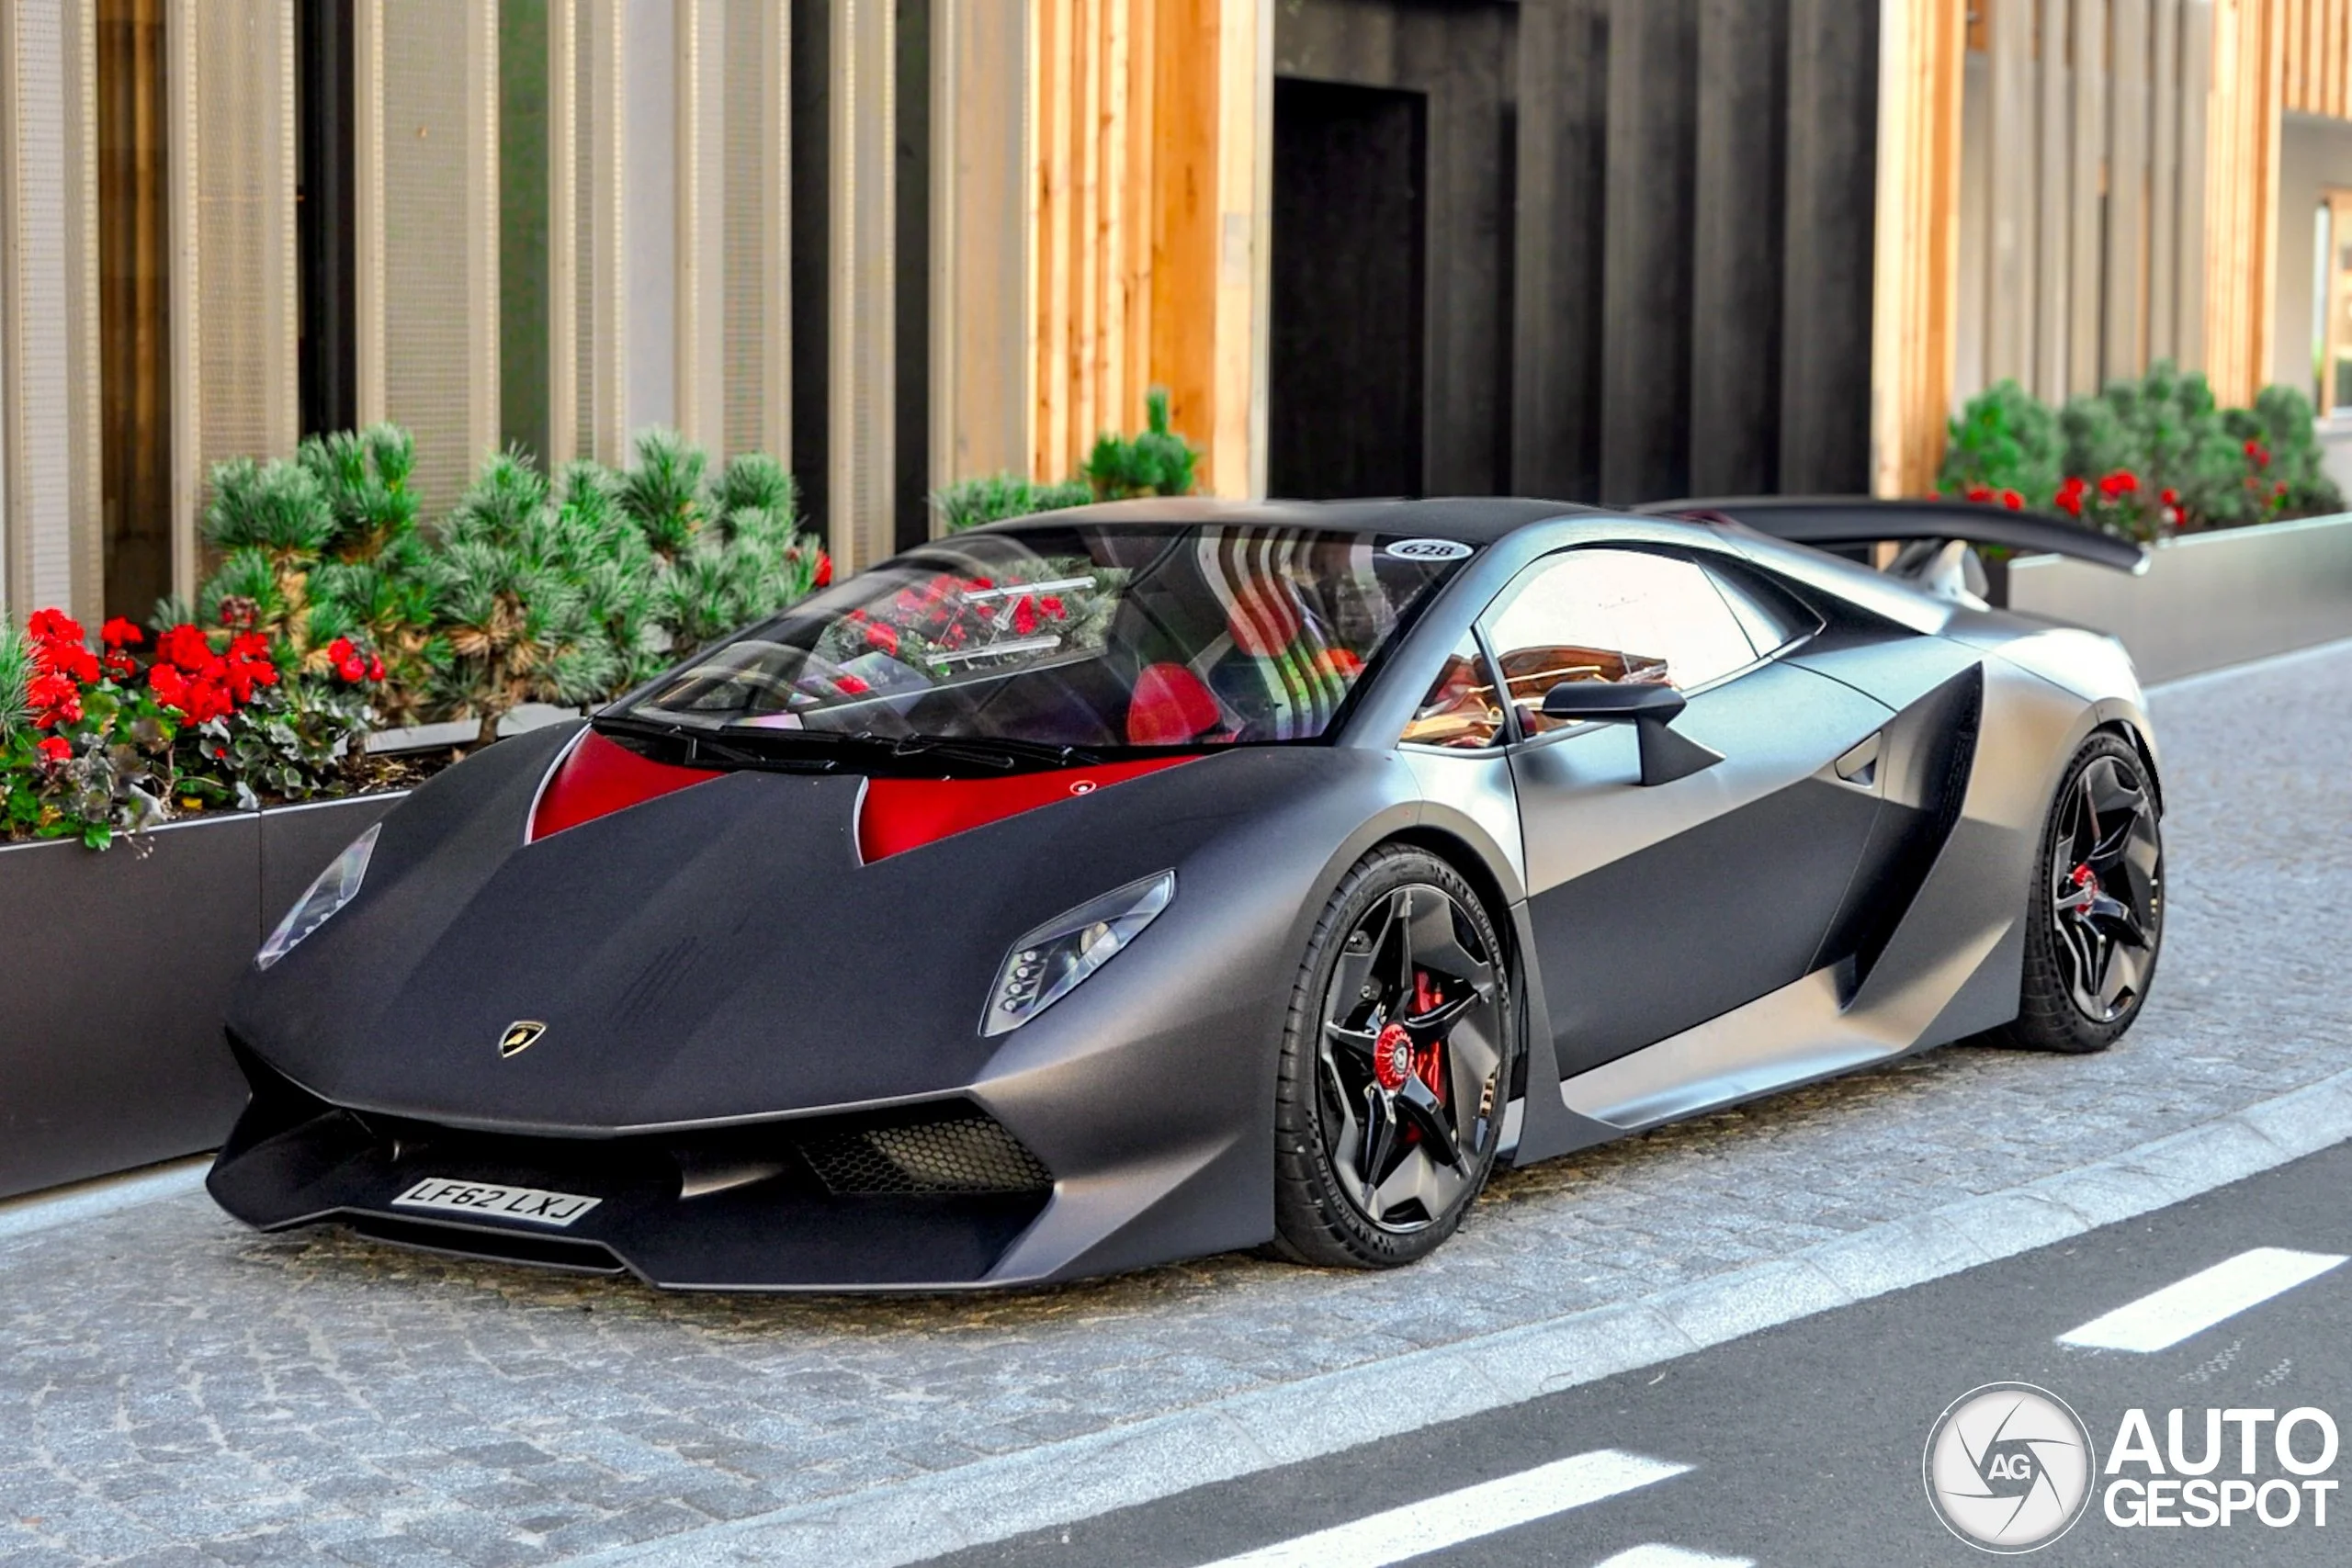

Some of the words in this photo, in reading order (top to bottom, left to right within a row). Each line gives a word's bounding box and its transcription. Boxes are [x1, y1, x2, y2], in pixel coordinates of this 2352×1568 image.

[1402, 544, 1455, 557] 628
[1465, 892, 1502, 968] MICHELIN
[407, 1182, 507, 1208] LF62
[503, 1193, 587, 1219] LXJ
[1317, 1156, 1359, 1230] MICHELIN
